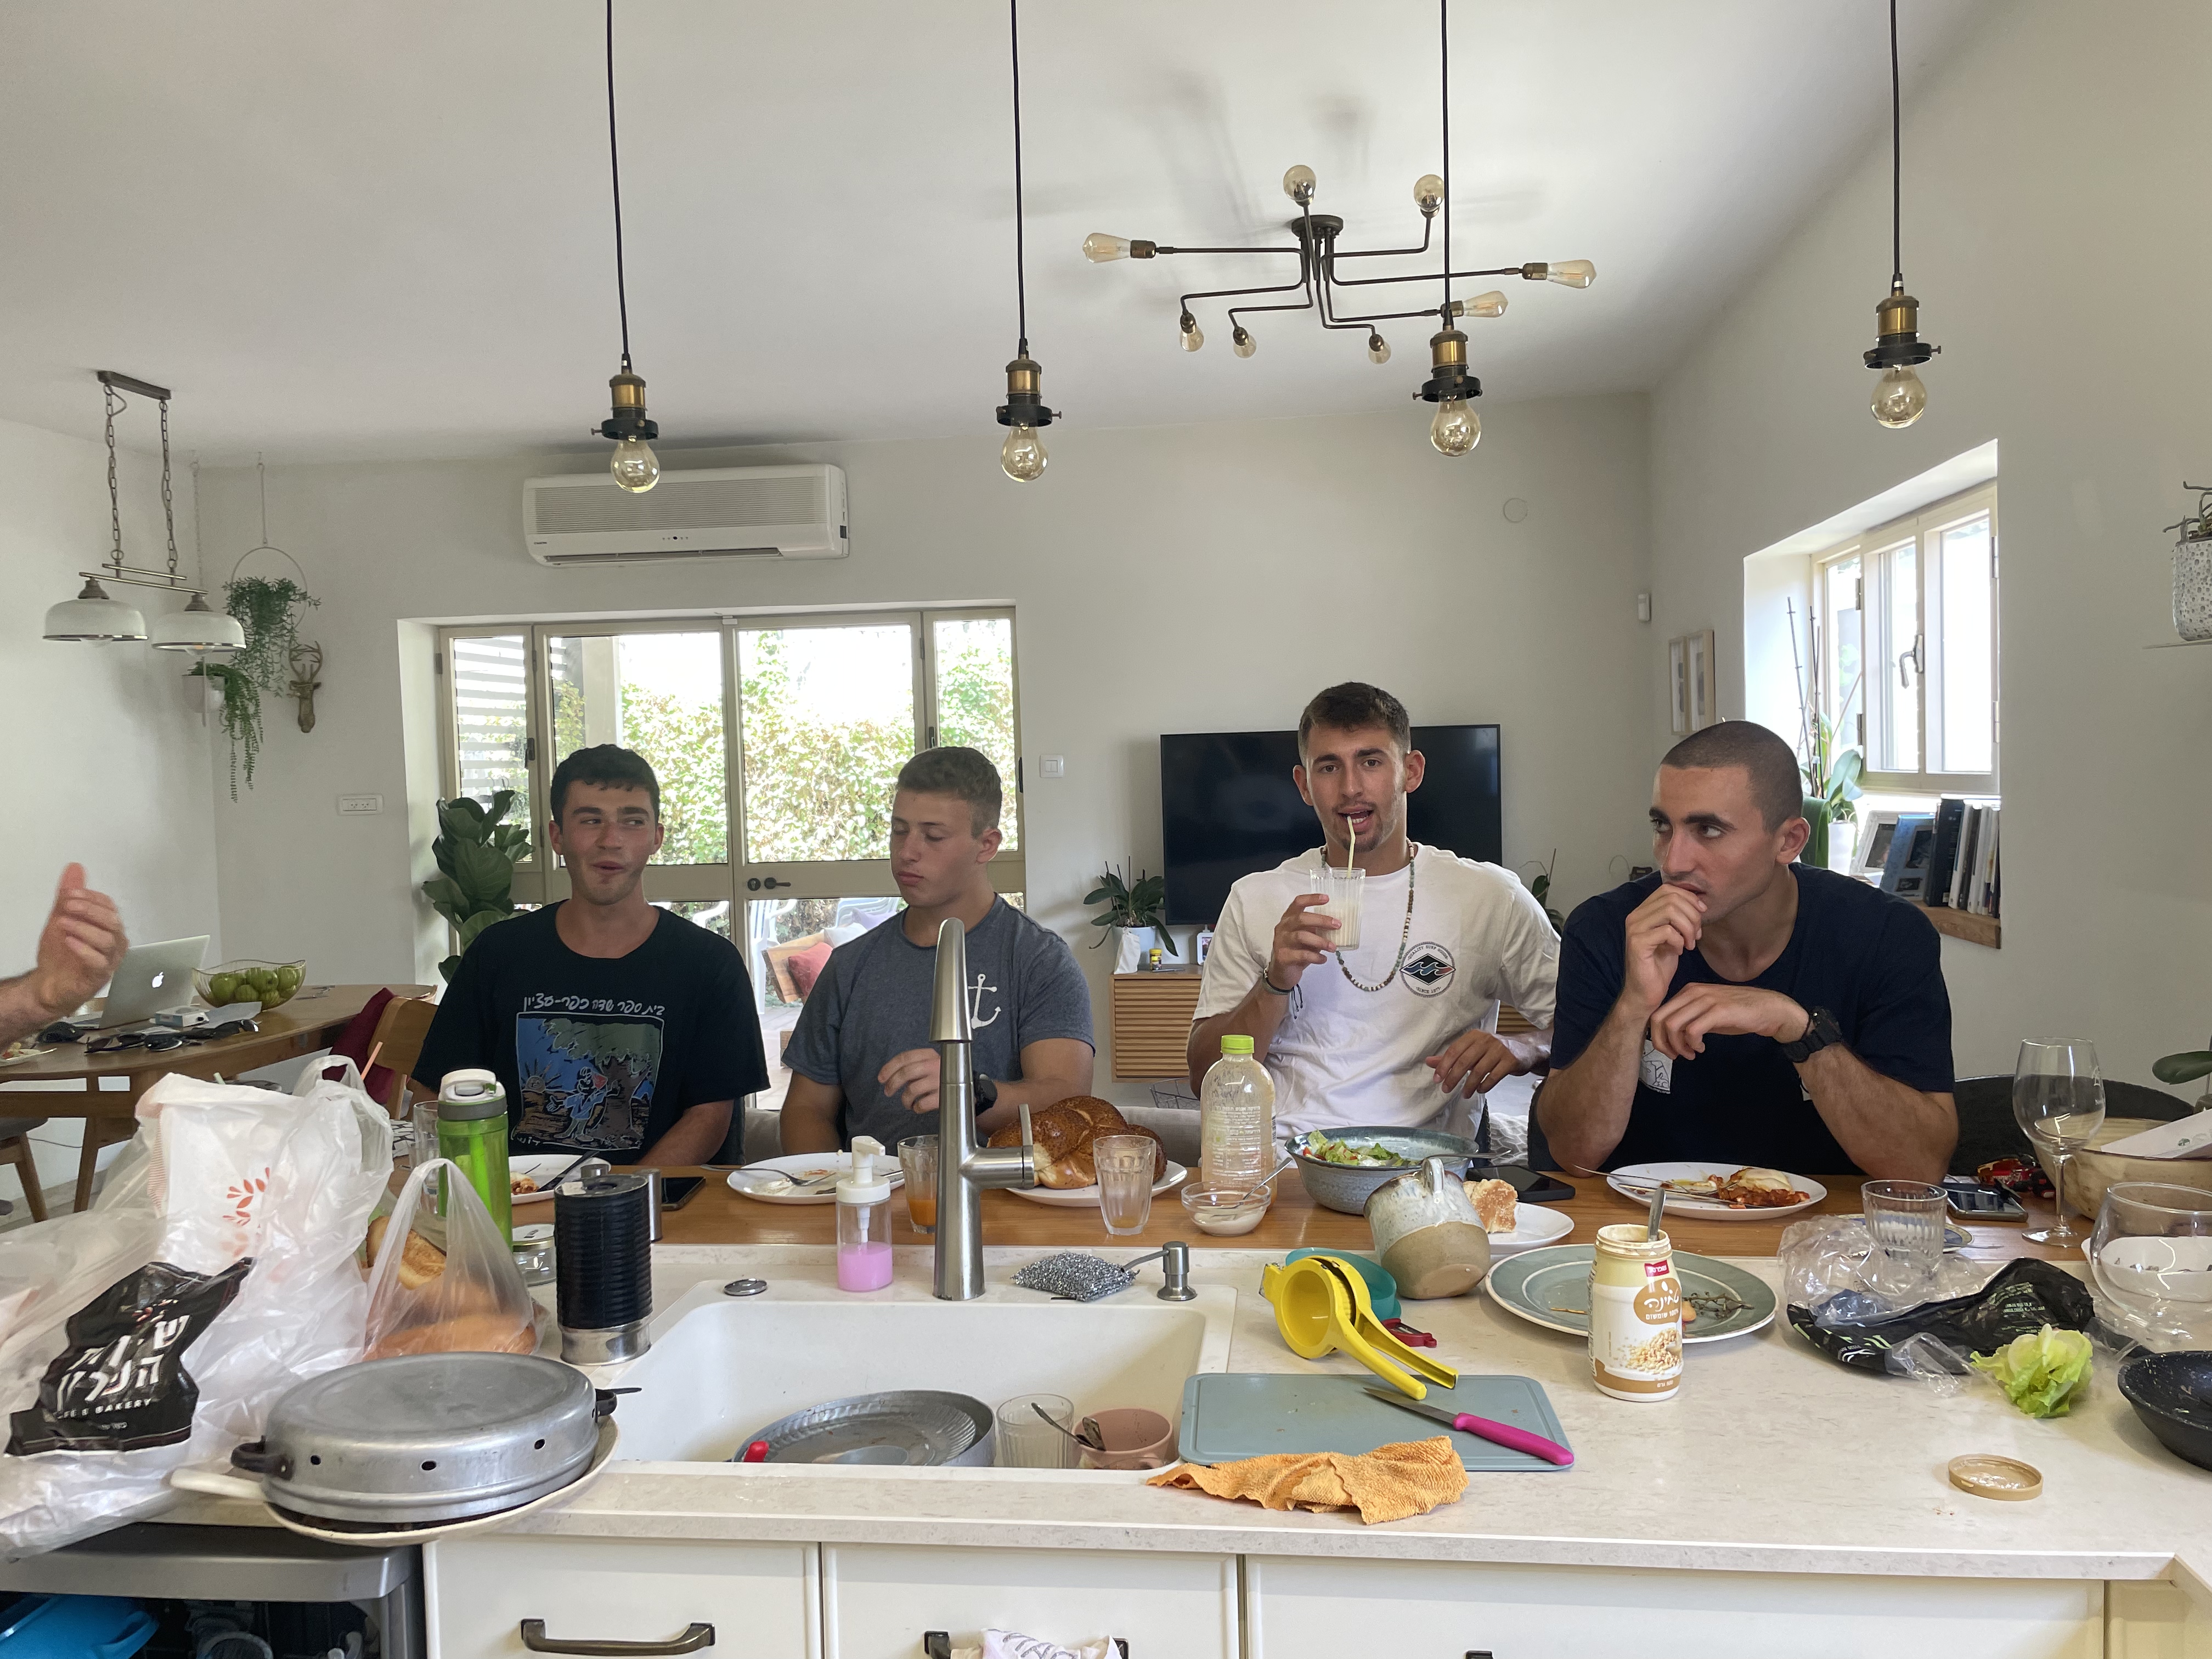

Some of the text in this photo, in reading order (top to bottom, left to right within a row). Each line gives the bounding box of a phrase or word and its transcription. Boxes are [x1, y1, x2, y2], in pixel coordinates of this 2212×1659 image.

[524, 993, 665, 1015] בית ספר שדה כפר-עציון
[1644, 1287, 1679, 1312] טחינה
[1645, 1312, 1668, 1321] שומשום
[95, 1398, 151, 1414] BAKERY
